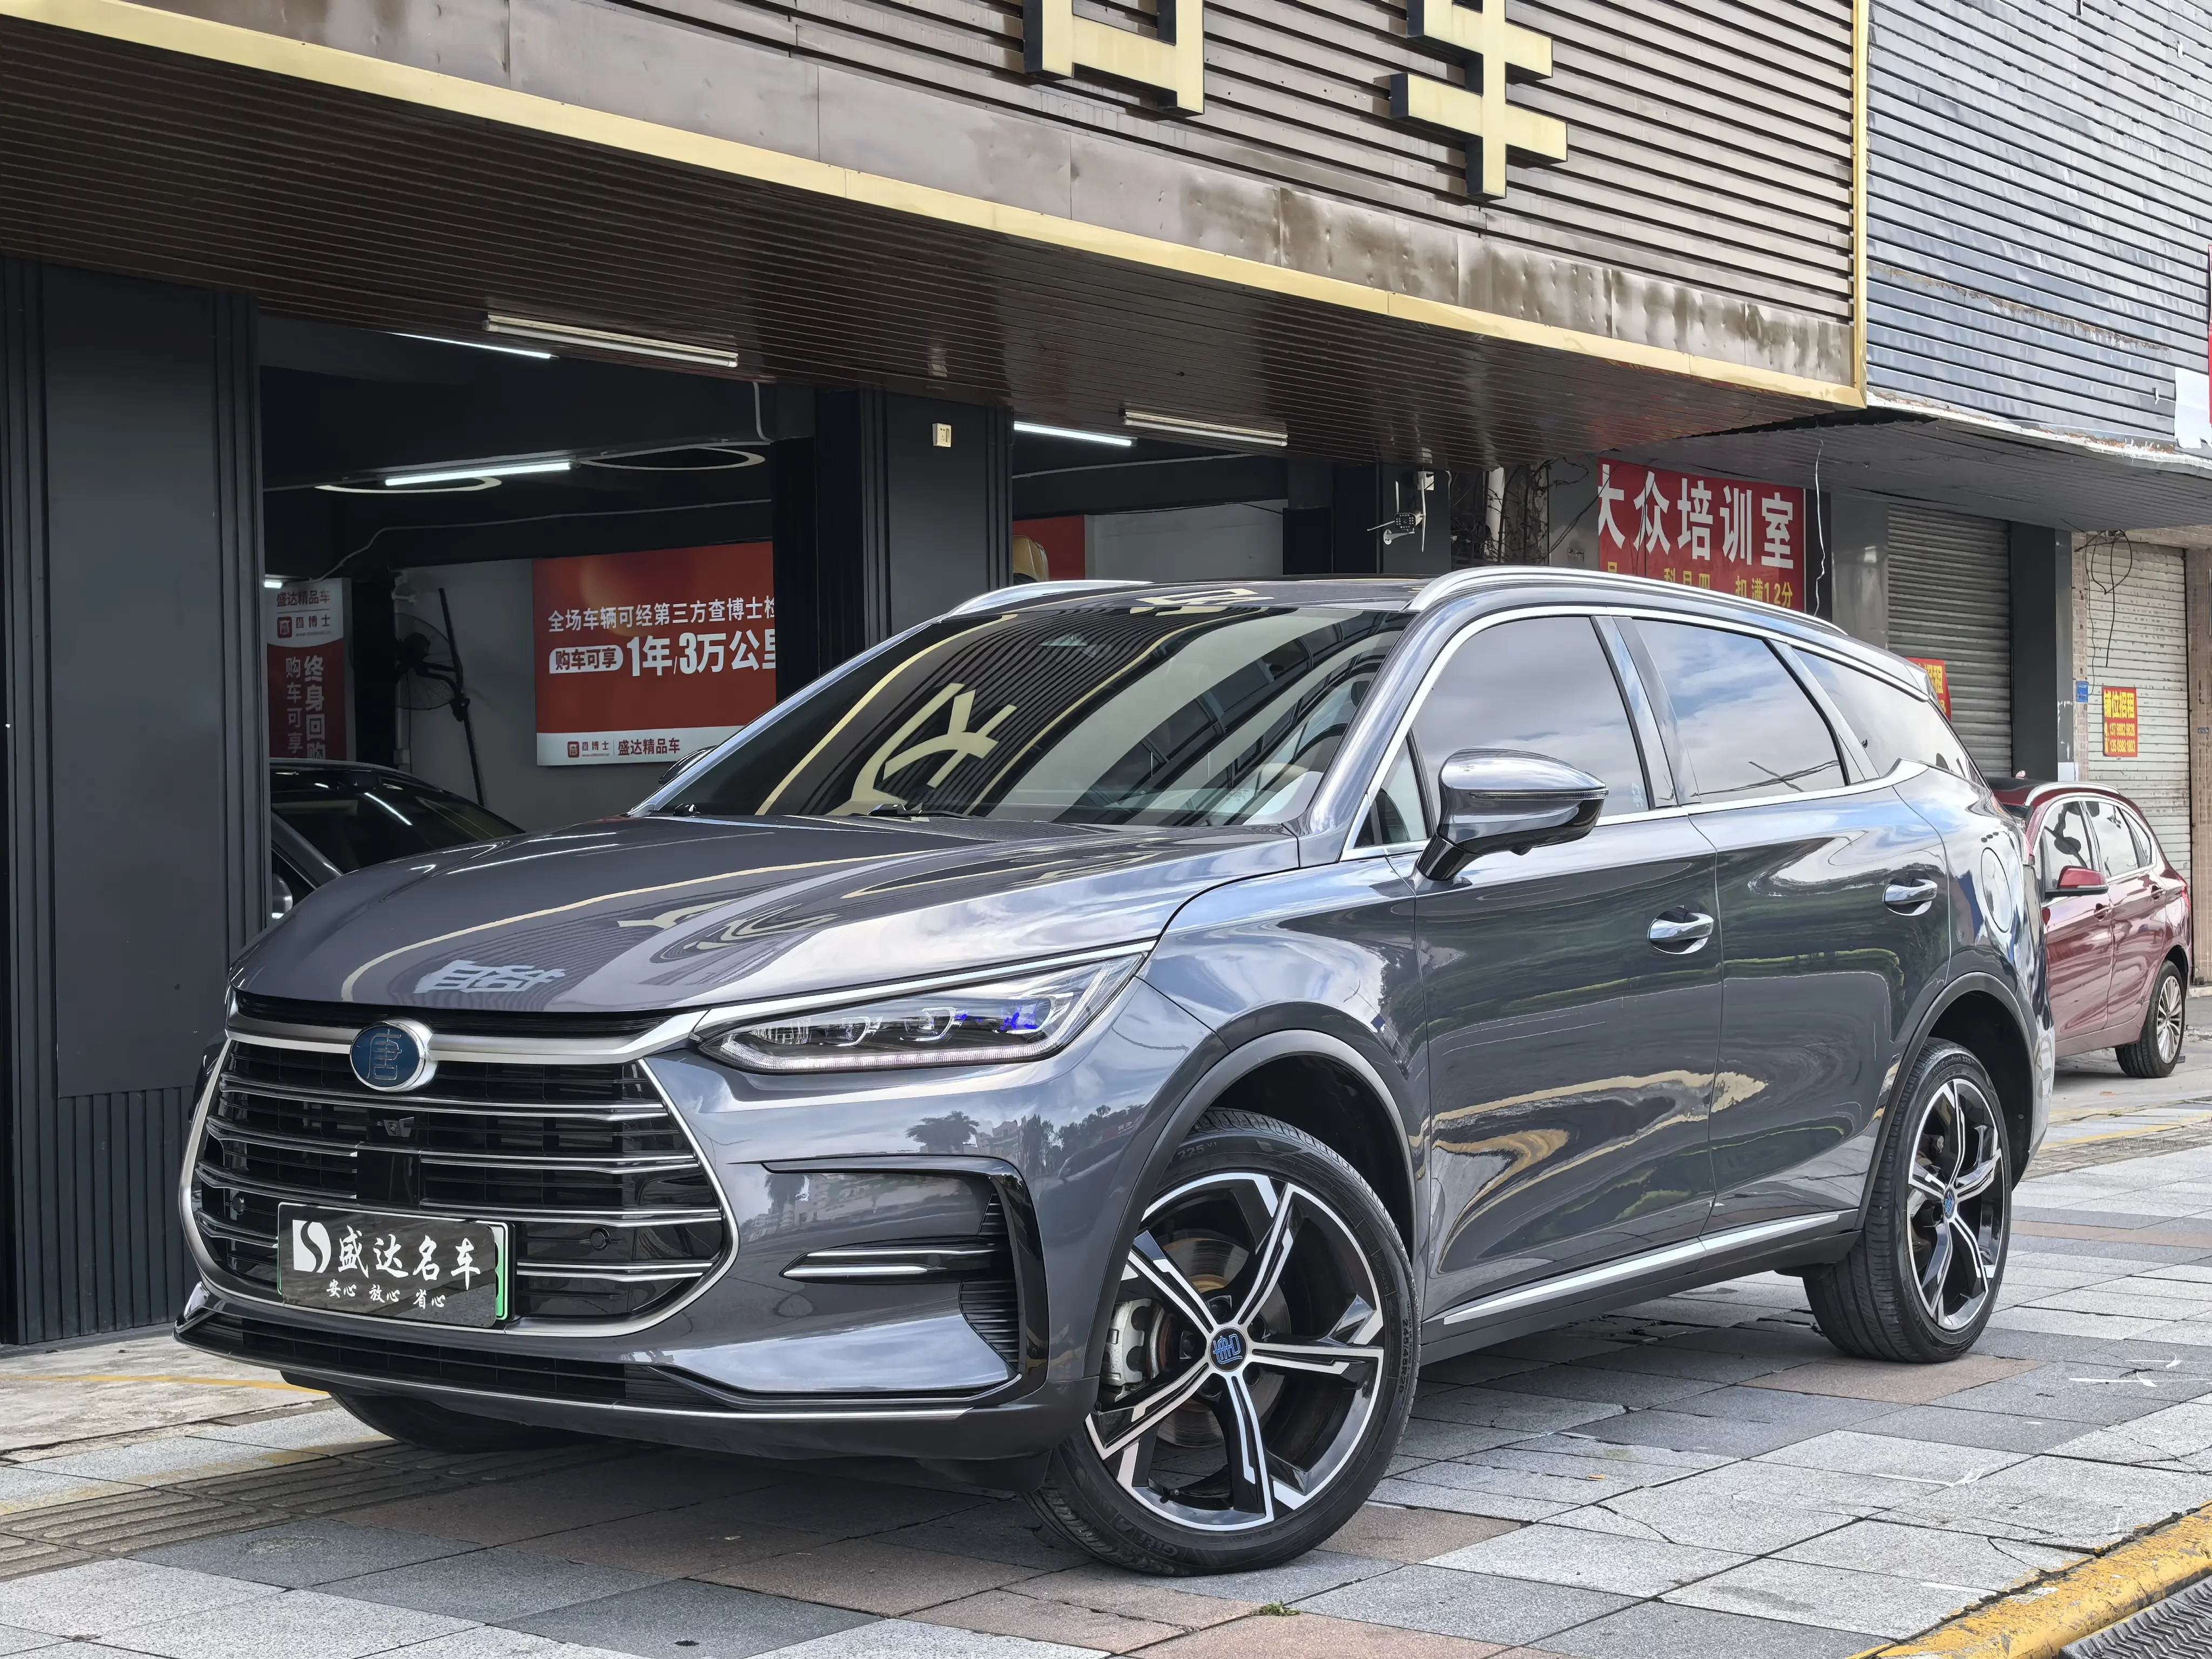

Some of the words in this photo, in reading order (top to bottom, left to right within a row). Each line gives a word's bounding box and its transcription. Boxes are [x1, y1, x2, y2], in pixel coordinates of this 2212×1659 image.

[1598, 463, 1793, 569] 大众培训室
[555, 648, 617, 670] 购车可享
[286, 656, 304, 754] 购车可享
[618, 737, 680, 756] 盛达精品车
[338, 1225, 481, 1291] 盛达名车
[326, 1279, 357, 1298] 安心
[369, 1284, 401, 1303] 放心
[413, 1289, 446, 1310] 省心
